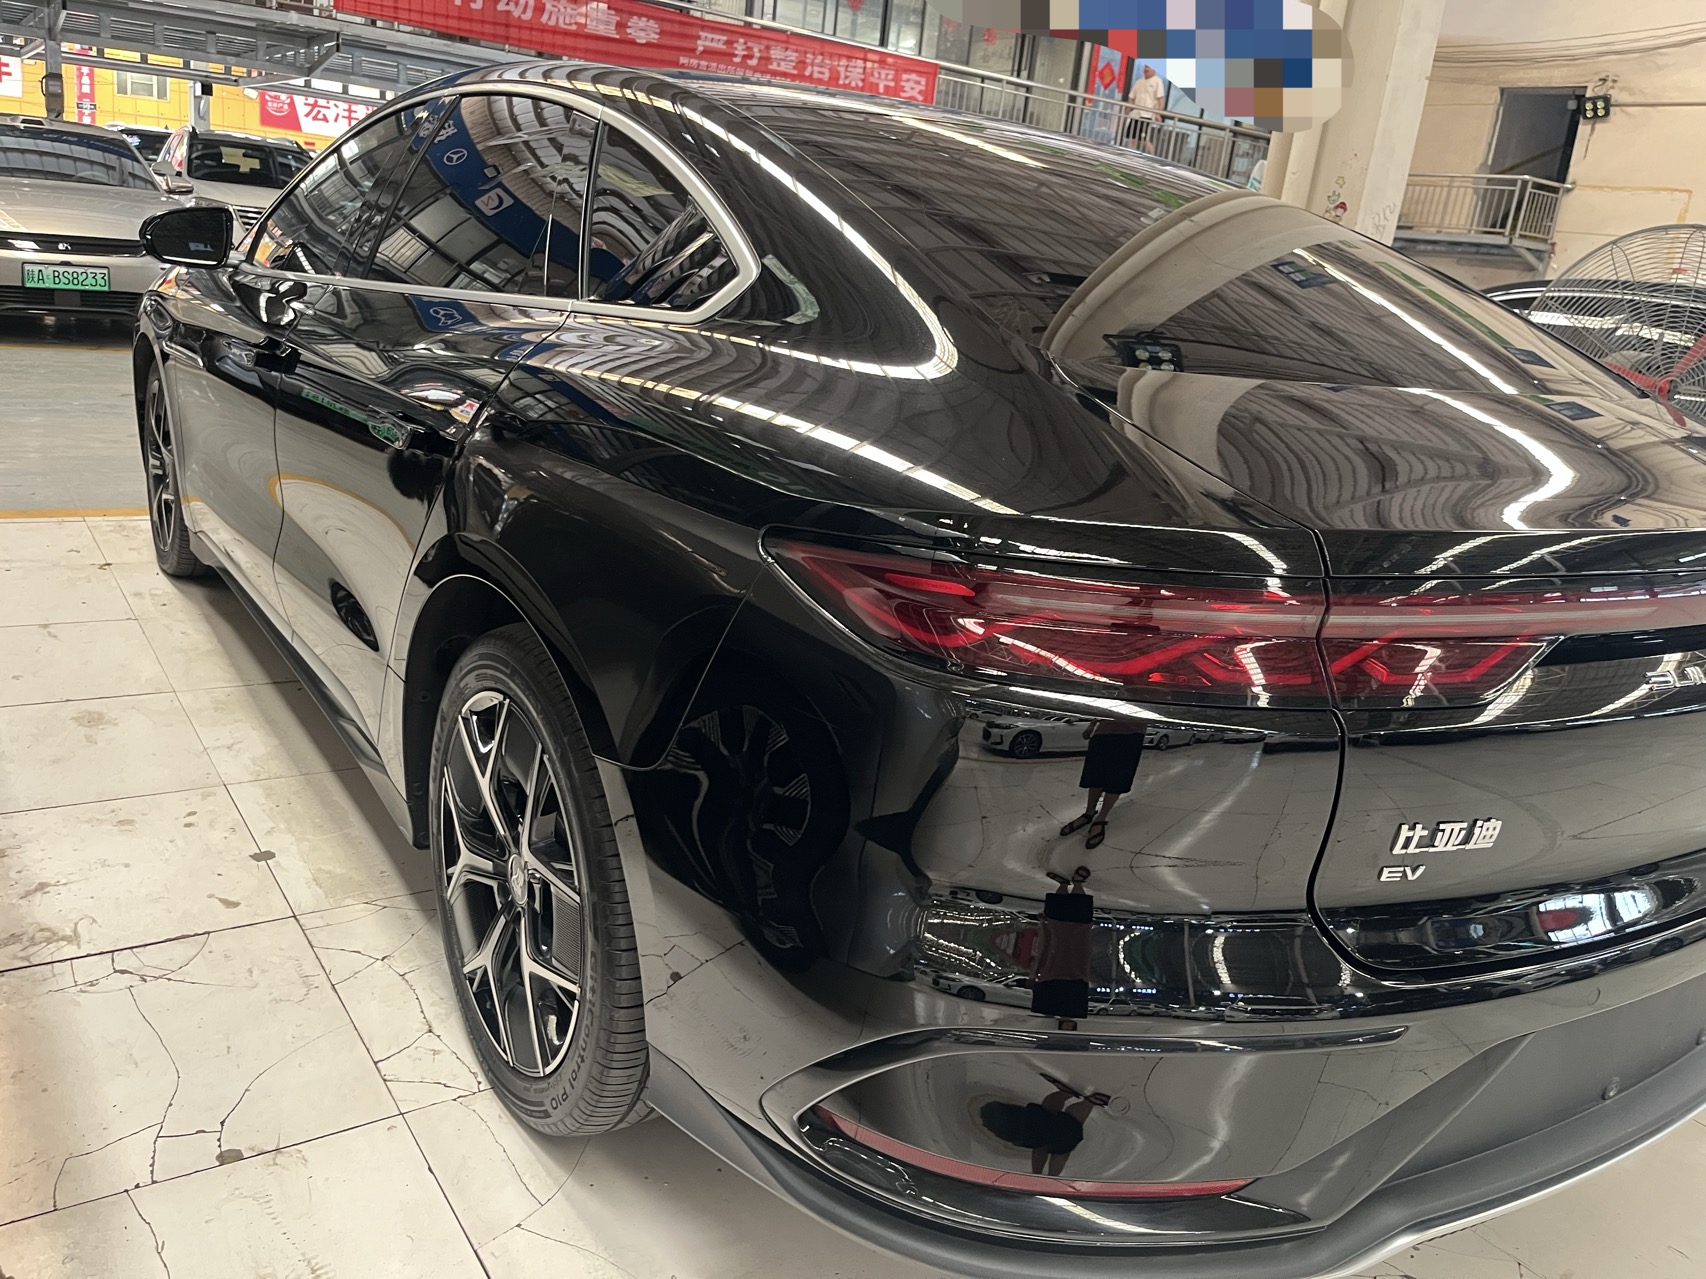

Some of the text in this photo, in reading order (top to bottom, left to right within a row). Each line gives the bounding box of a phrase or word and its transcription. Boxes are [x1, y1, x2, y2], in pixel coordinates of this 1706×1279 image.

[696, 30, 927, 101] 严打整治保平安
[1392, 819, 1502, 854] 比亚迪
[1379, 866, 1426, 881] EV
